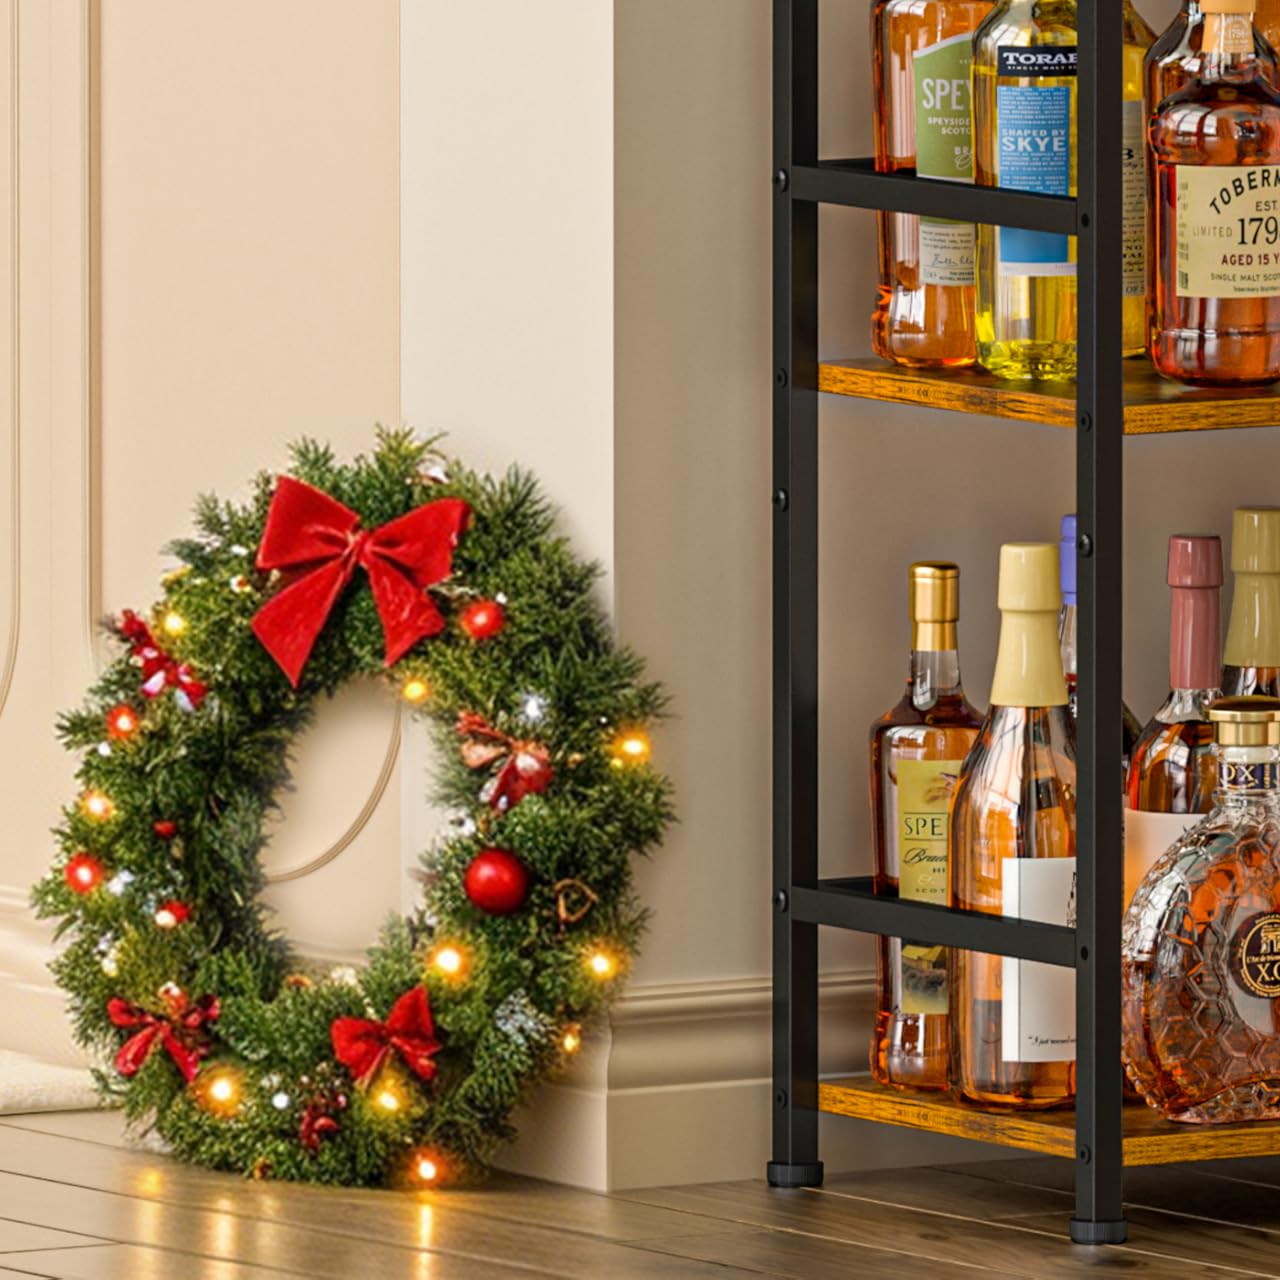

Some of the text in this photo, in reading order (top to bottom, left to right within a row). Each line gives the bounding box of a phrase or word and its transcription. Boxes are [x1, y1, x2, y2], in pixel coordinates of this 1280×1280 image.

[1002, 127, 1067, 138] SHAPED BY
[1002, 138, 1067, 153] SKYE
[1192, 226, 1233, 238] LIMITED
[1220, 253, 1254, 266] AGED
[1258, 253, 1270, 265] 15
[1210, 273, 1238, 282] SINGLE
[1240, 272, 1260, 282] MALT
